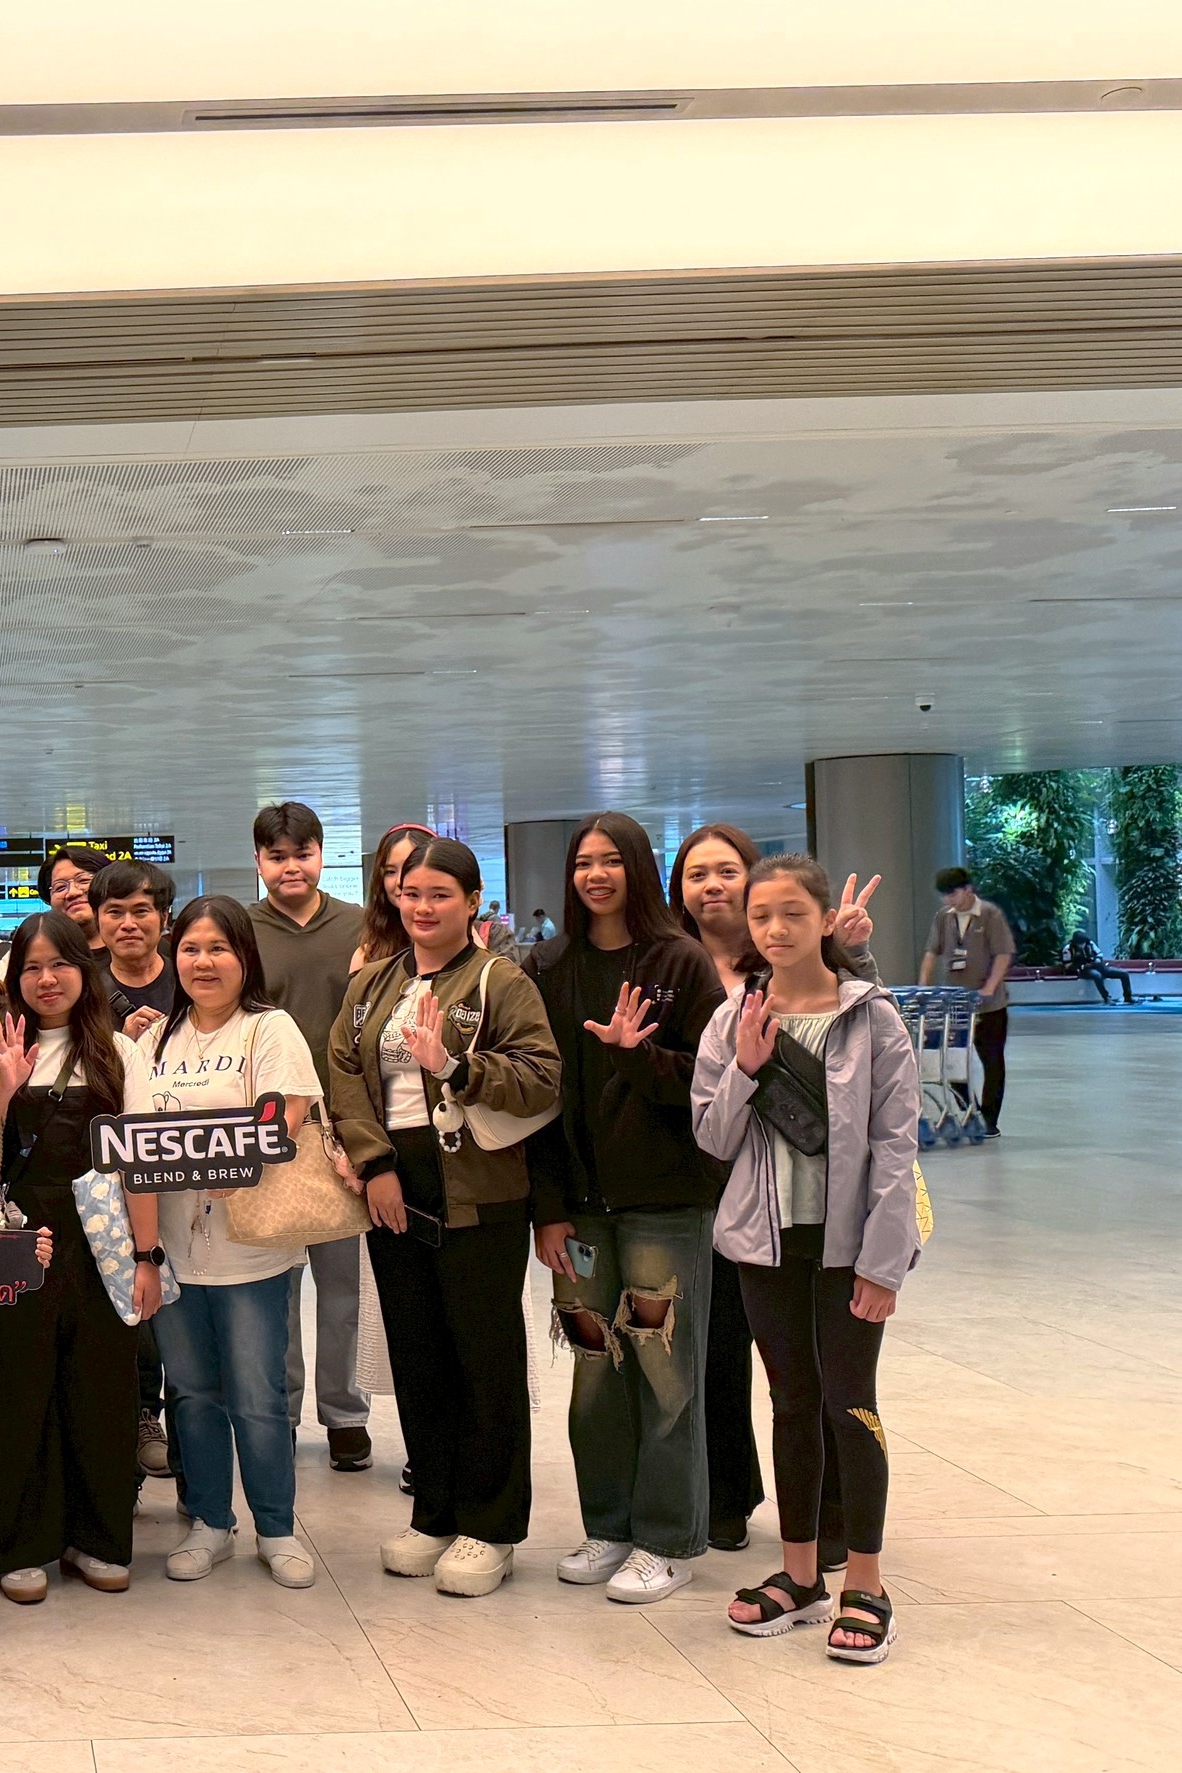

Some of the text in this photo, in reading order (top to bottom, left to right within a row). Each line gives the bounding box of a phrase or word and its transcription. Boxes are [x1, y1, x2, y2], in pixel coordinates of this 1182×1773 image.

[88, 841, 107, 850] Taxi
[118, 851, 132, 860] 2A
[149, 1055, 246, 1081] MARDI
[172, 1078, 209, 1088] Mercredi
[100, 1101, 282, 1165] NESCAFÉ
[133, 1167, 254, 1185] BLEND & BREW
